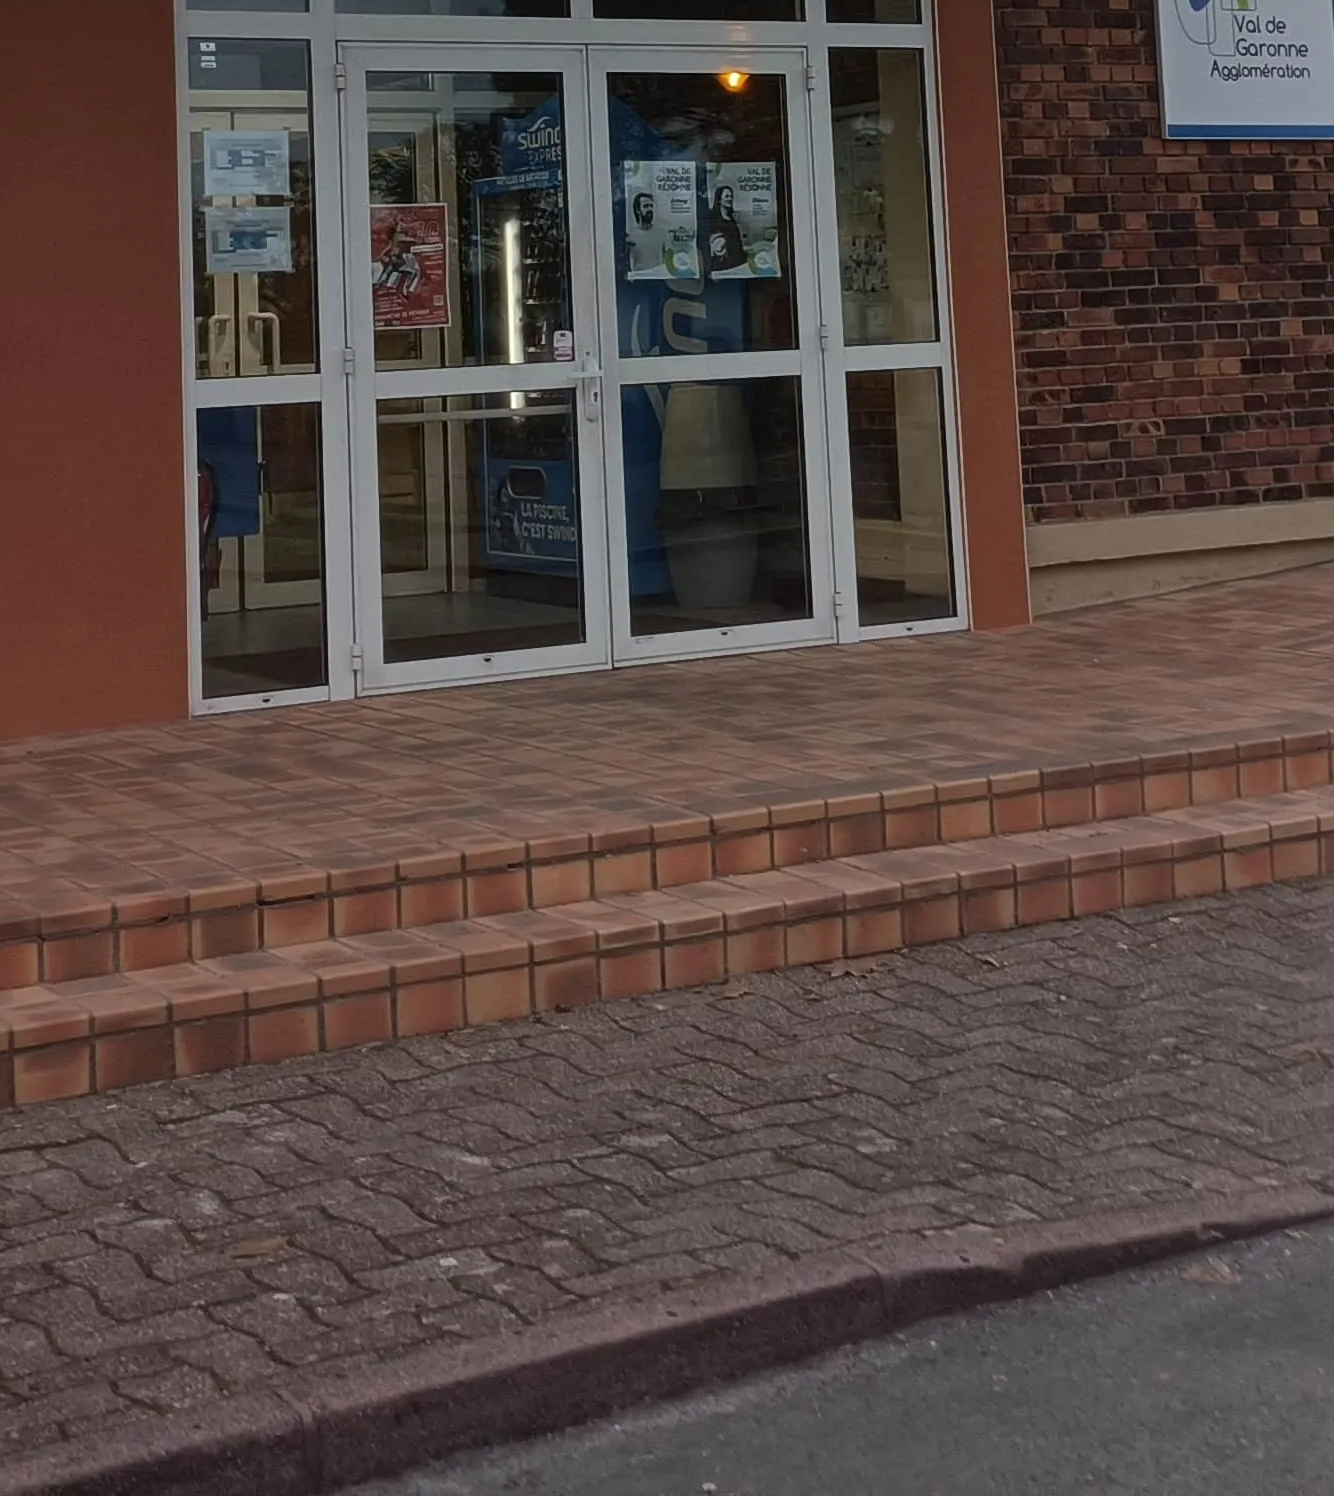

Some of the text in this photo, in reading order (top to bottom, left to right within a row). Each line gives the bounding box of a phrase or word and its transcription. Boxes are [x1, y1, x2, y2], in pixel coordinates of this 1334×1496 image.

[1235, 15, 1287, 34] Val de
[1235, 38, 1309, 58] Garonne
[1210, 59, 1311, 82] Agglomération
